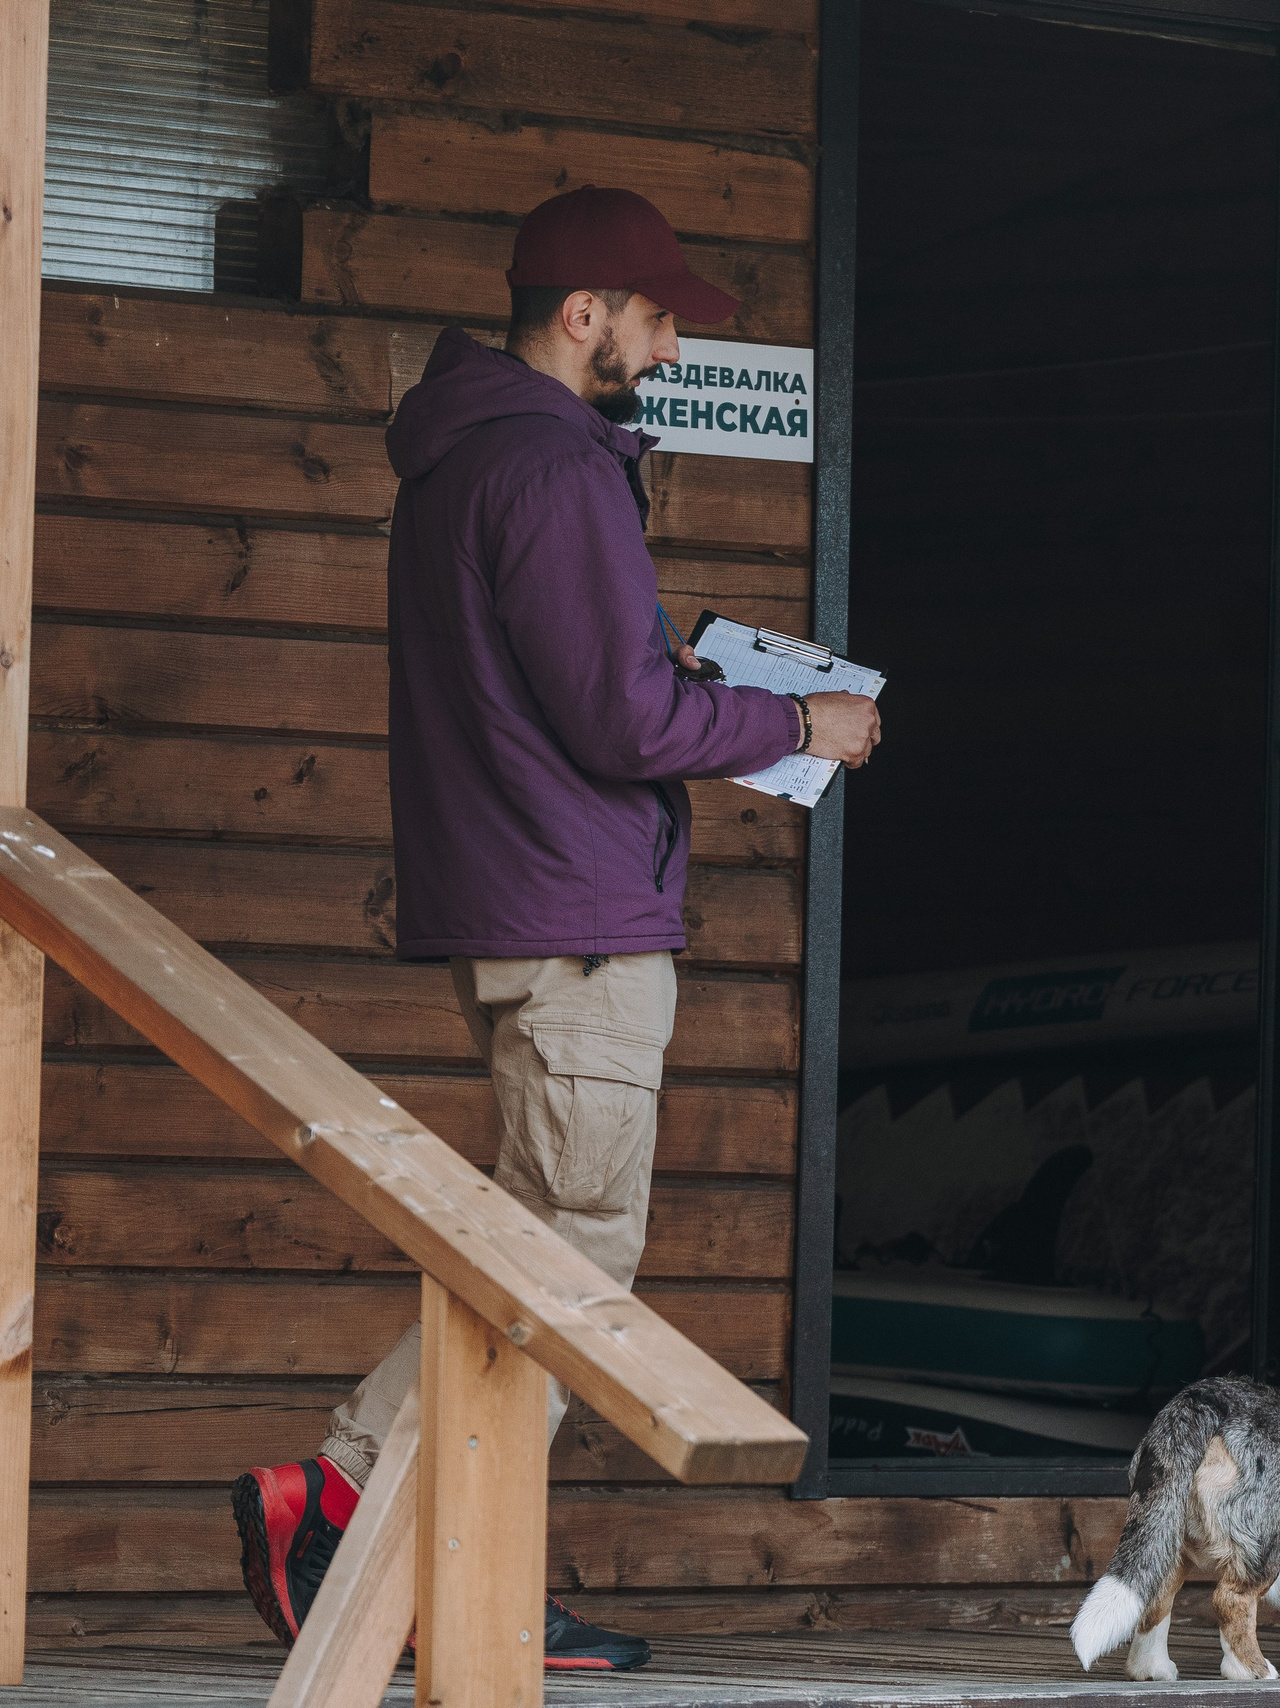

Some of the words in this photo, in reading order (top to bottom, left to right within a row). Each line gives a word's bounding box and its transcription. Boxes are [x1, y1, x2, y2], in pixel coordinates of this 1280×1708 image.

[648, 362, 807, 395] АЗДЕВАЛКА
[633, 395, 808, 438] ЖЕНСКАЯ
[983, 980, 1110, 1016] HYDRO
[1125, 969, 1257, 1002] FORCE
